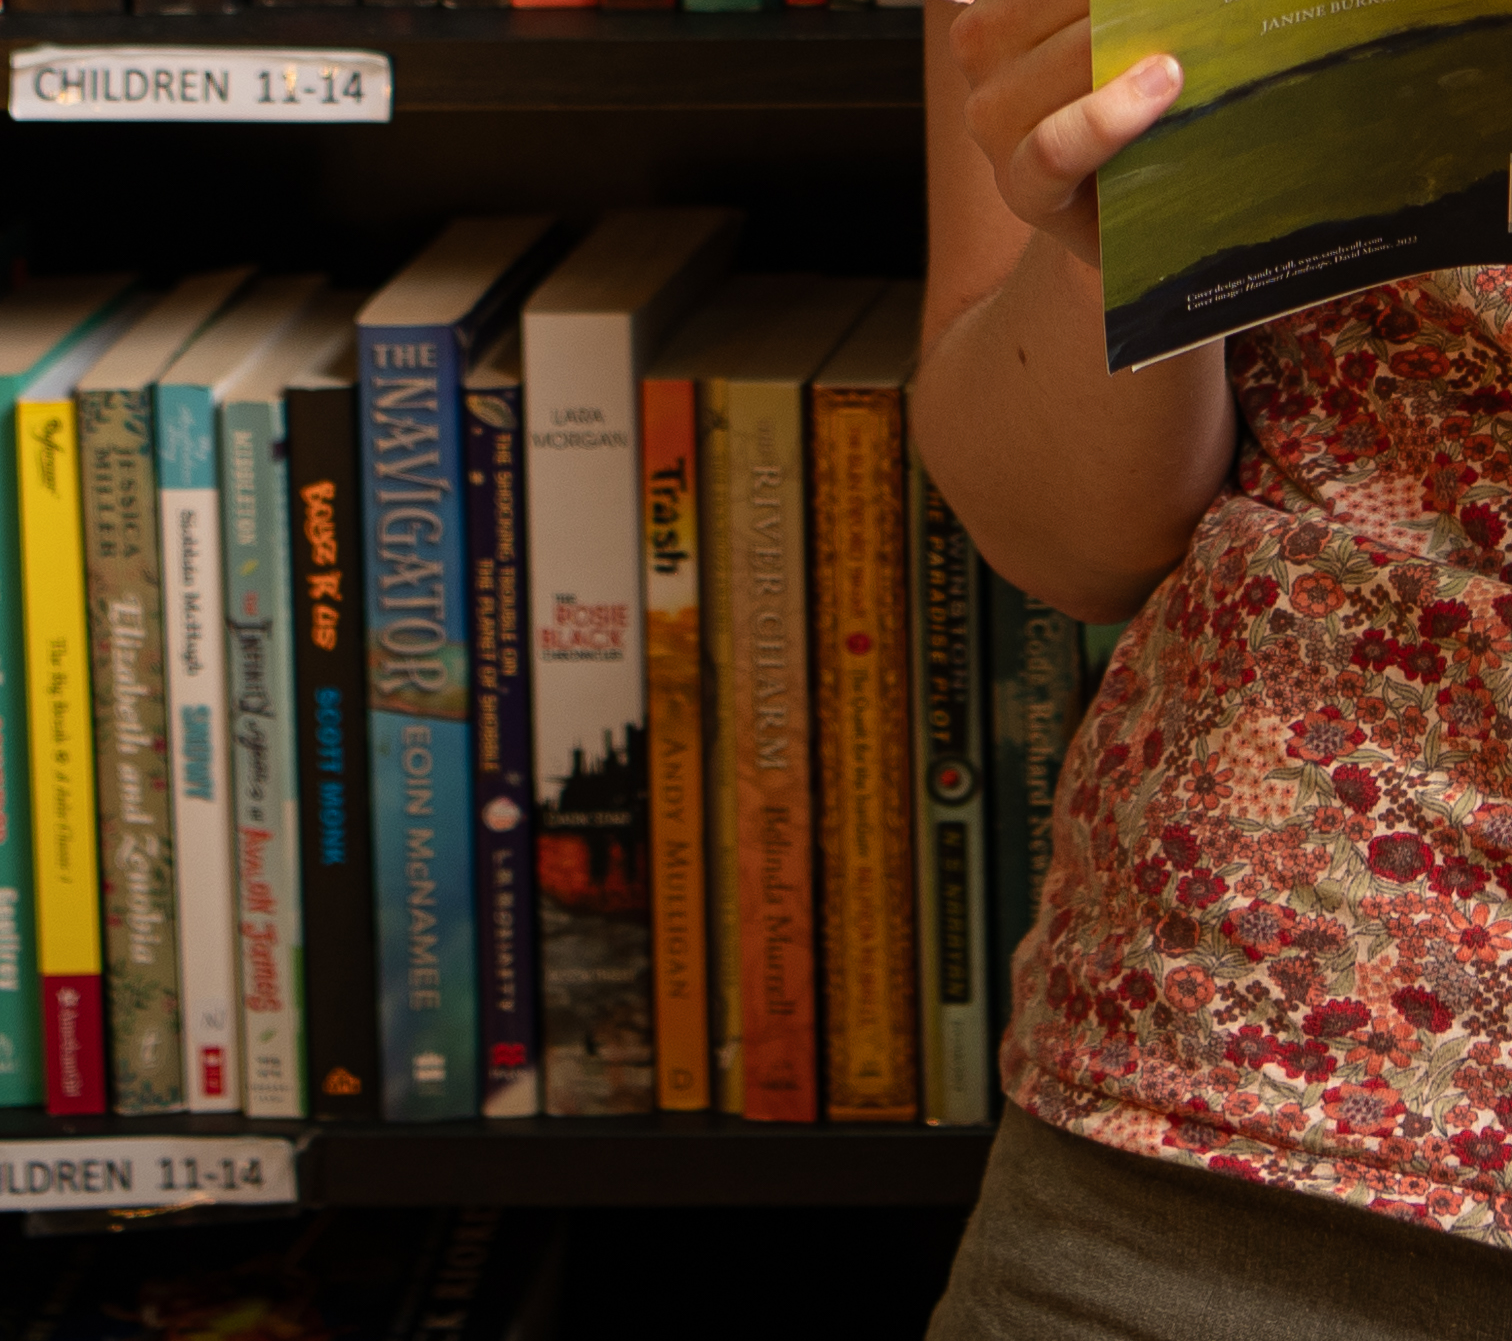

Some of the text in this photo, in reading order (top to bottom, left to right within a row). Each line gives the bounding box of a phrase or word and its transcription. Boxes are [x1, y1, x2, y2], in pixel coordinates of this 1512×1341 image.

[1260, 5, 1327, 35] JANINE
[33, 69, 366, 106] CHILDREN 11-14
[373, 343, 437, 368] THE
[373, 374, 453, 694] NAVIGATOR
[158, 1160, 264, 1190] 11-14
